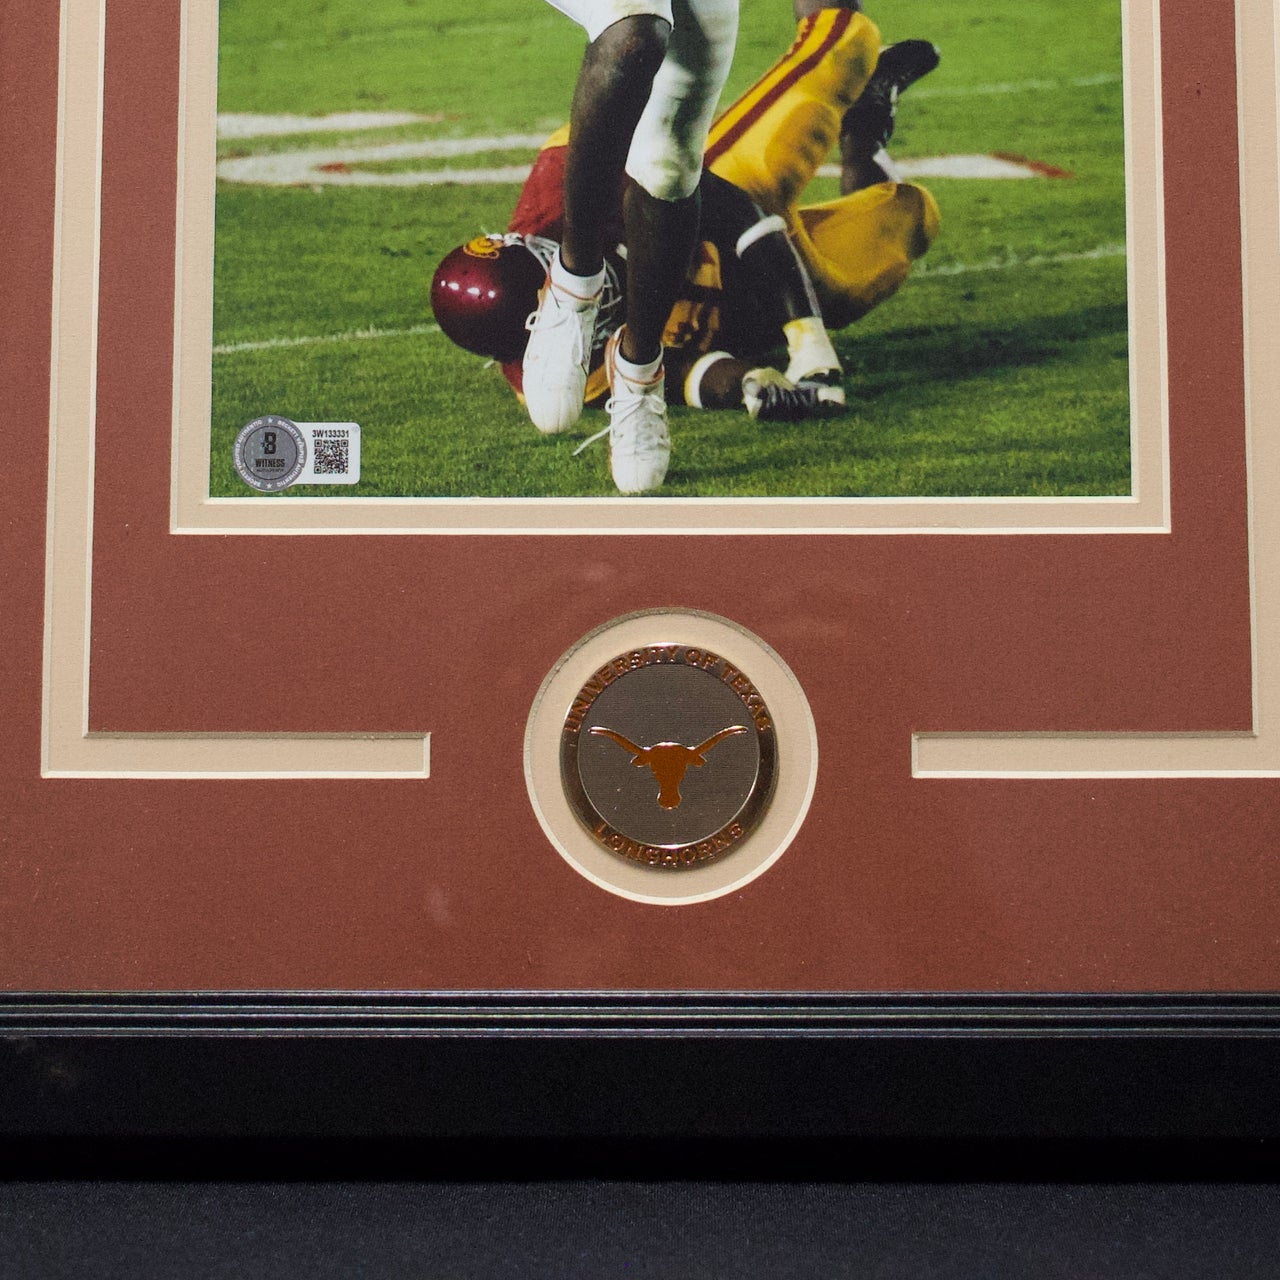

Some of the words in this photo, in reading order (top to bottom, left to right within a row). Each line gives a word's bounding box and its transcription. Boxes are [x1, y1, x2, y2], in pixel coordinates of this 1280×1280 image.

[255, 458, 286, 468] WITNESS
[564, 645, 684, 733] UNIVERSITY
[684, 648, 718, 669] OF
[720, 668, 772, 732] TEXAS
[593, 822, 745, 867] LONGHORNS
